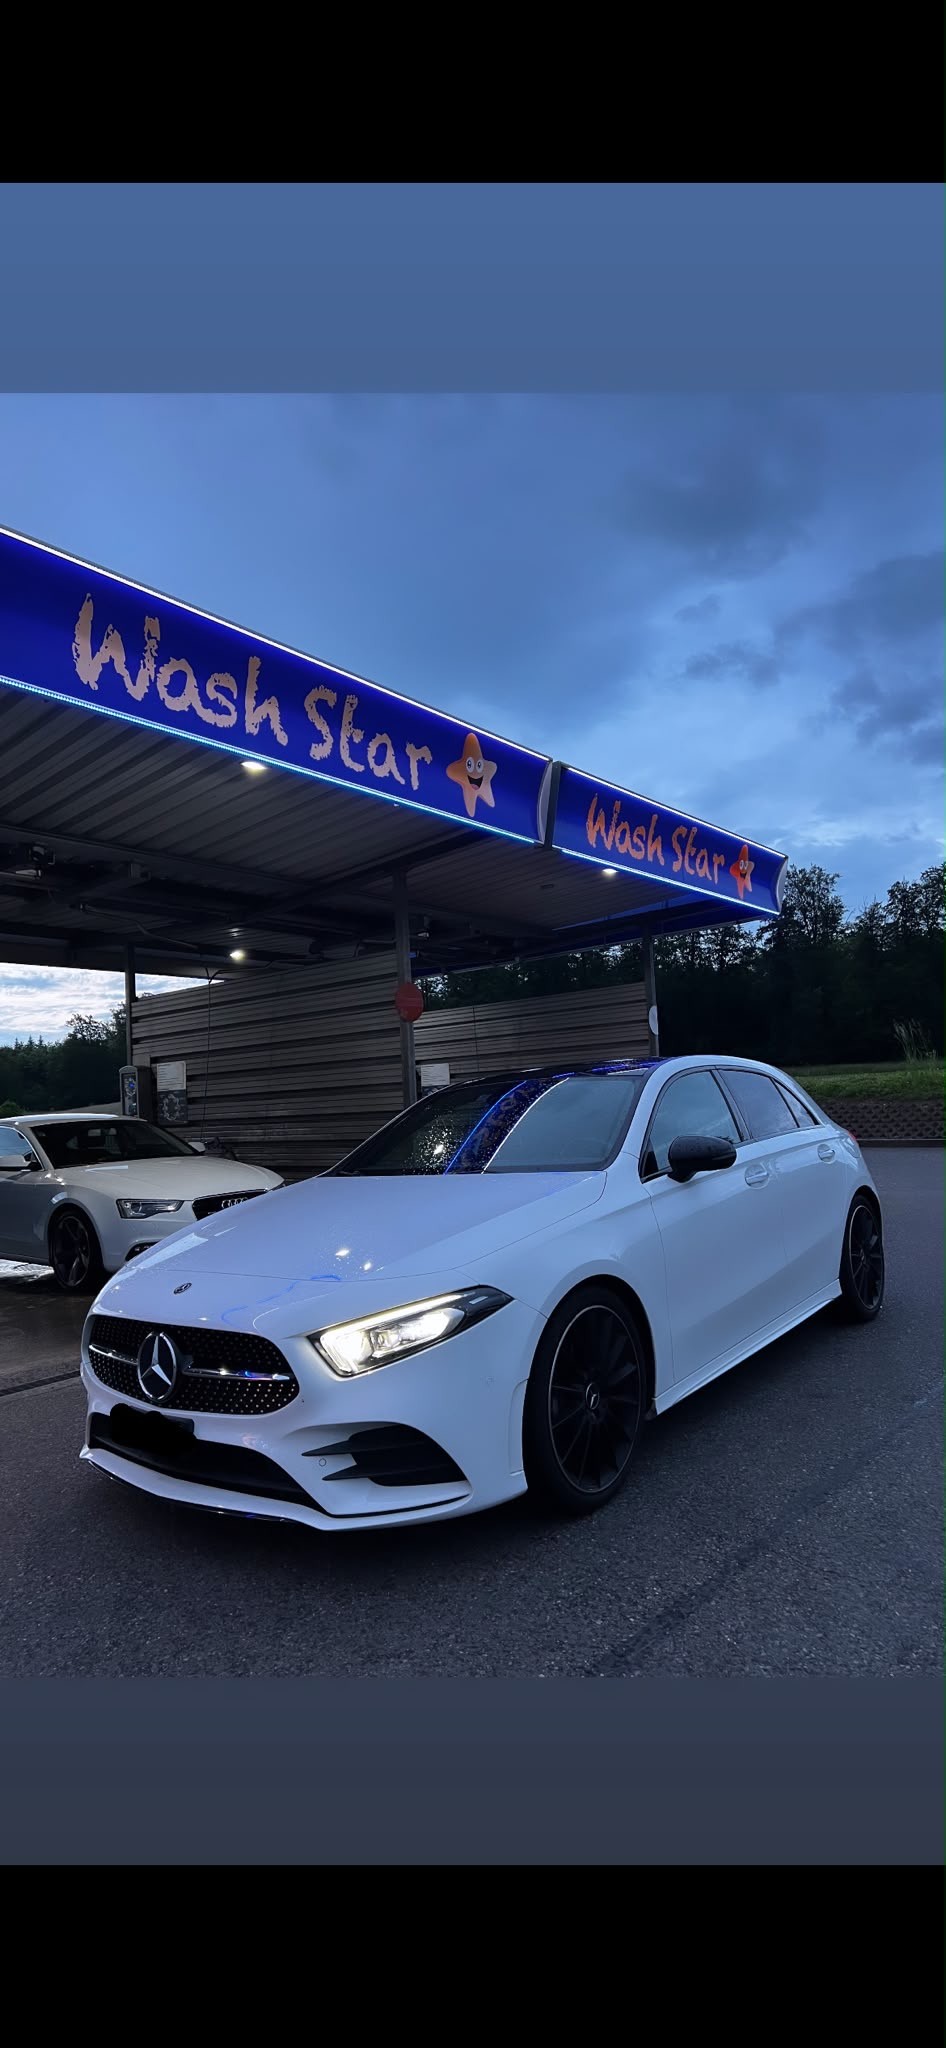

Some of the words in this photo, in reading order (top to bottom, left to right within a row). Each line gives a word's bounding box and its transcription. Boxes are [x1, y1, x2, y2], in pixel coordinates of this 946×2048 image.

[72, 593, 288, 746] Wash
[304, 685, 433, 790] Star
[586, 793, 664, 866] Wash
[672, 826, 724, 884] Star
